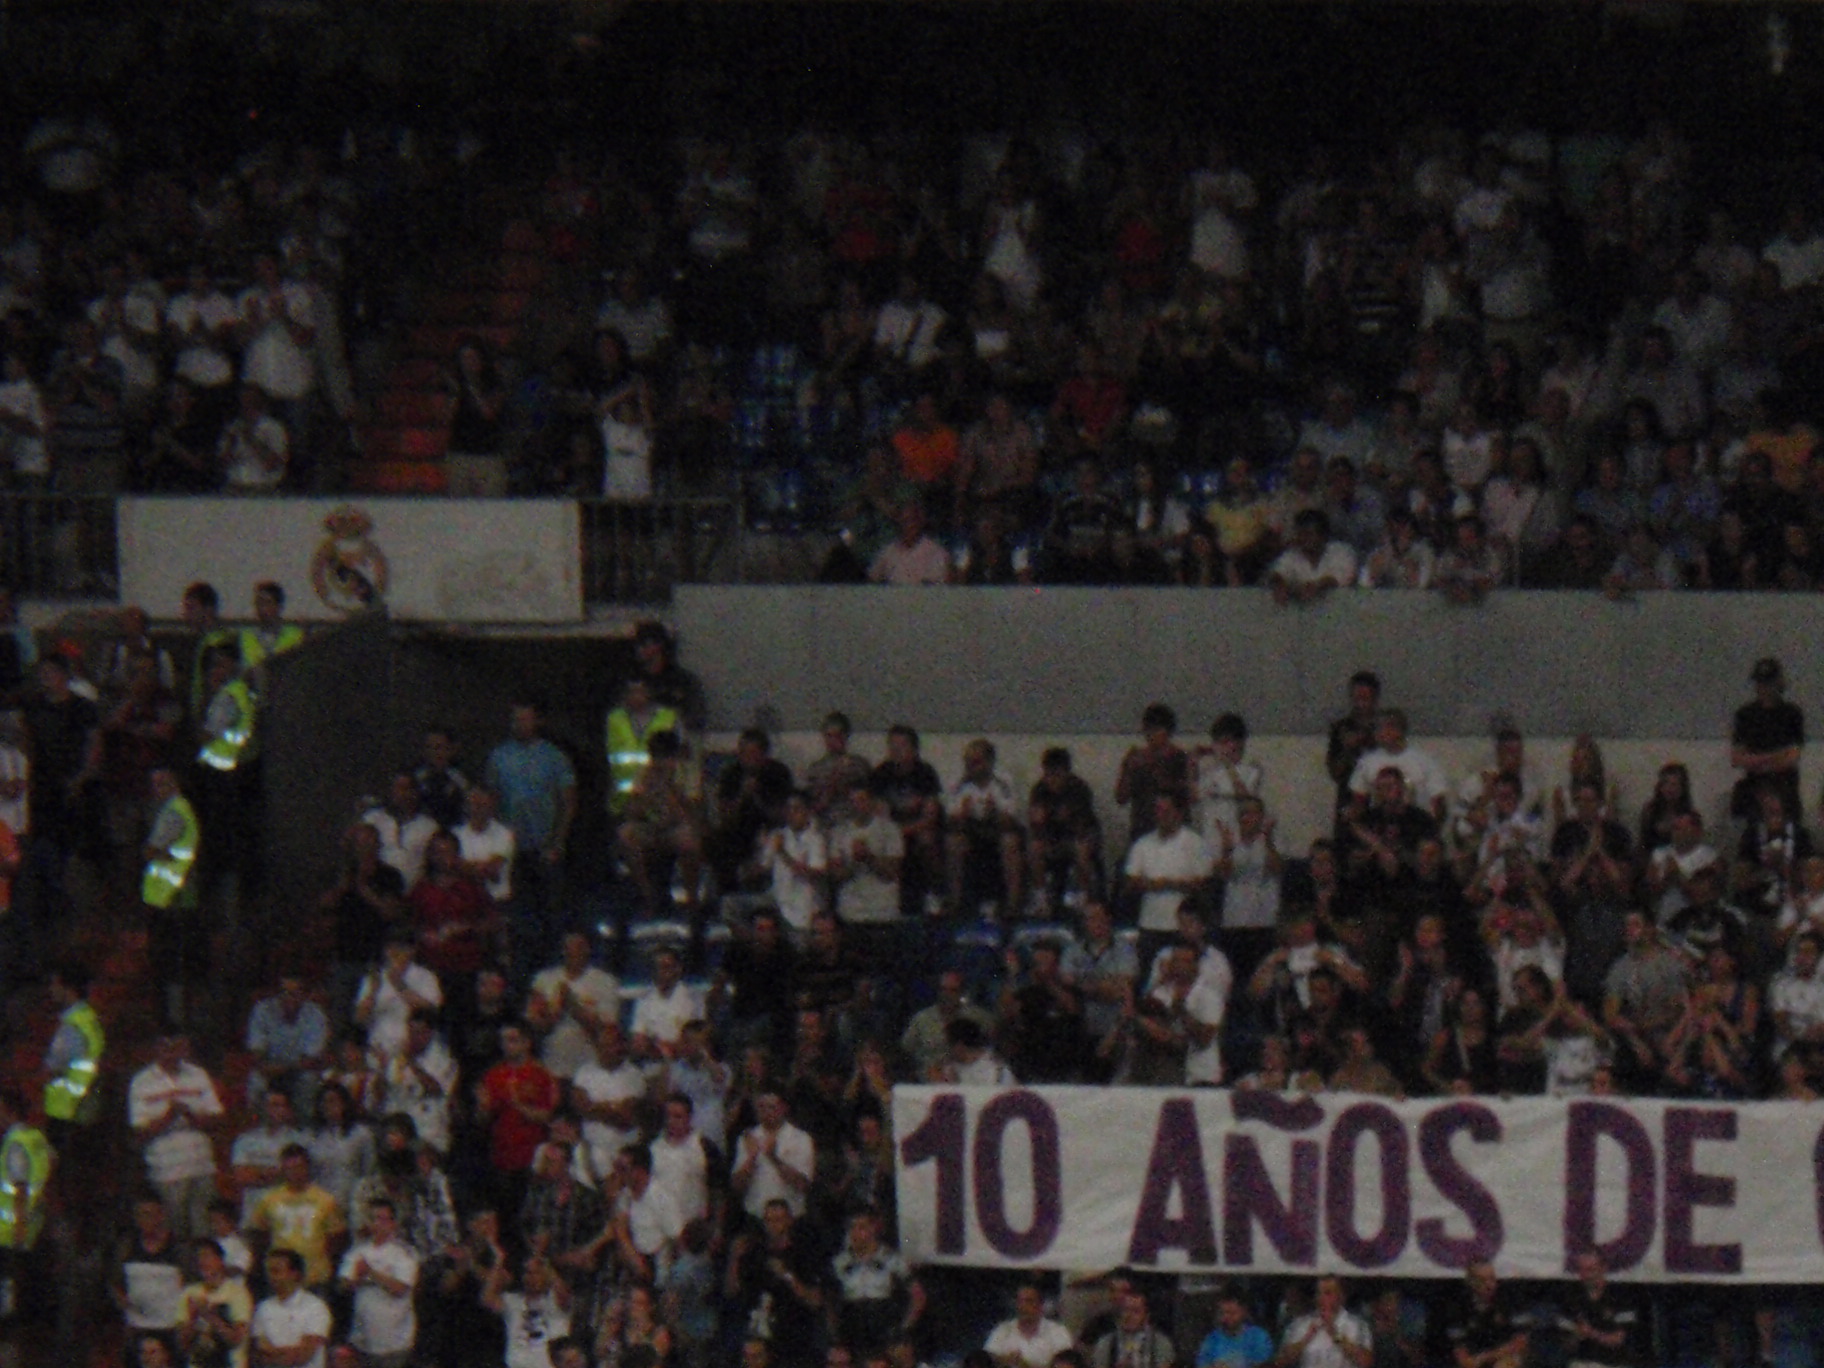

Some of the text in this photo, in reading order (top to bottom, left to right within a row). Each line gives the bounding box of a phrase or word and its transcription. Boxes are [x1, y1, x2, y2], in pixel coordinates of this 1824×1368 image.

[901, 1090, 1061, 1259] 10
[1128, 1089, 1505, 1269] AÑOS
[1563, 1100, 1743, 1275] DE
